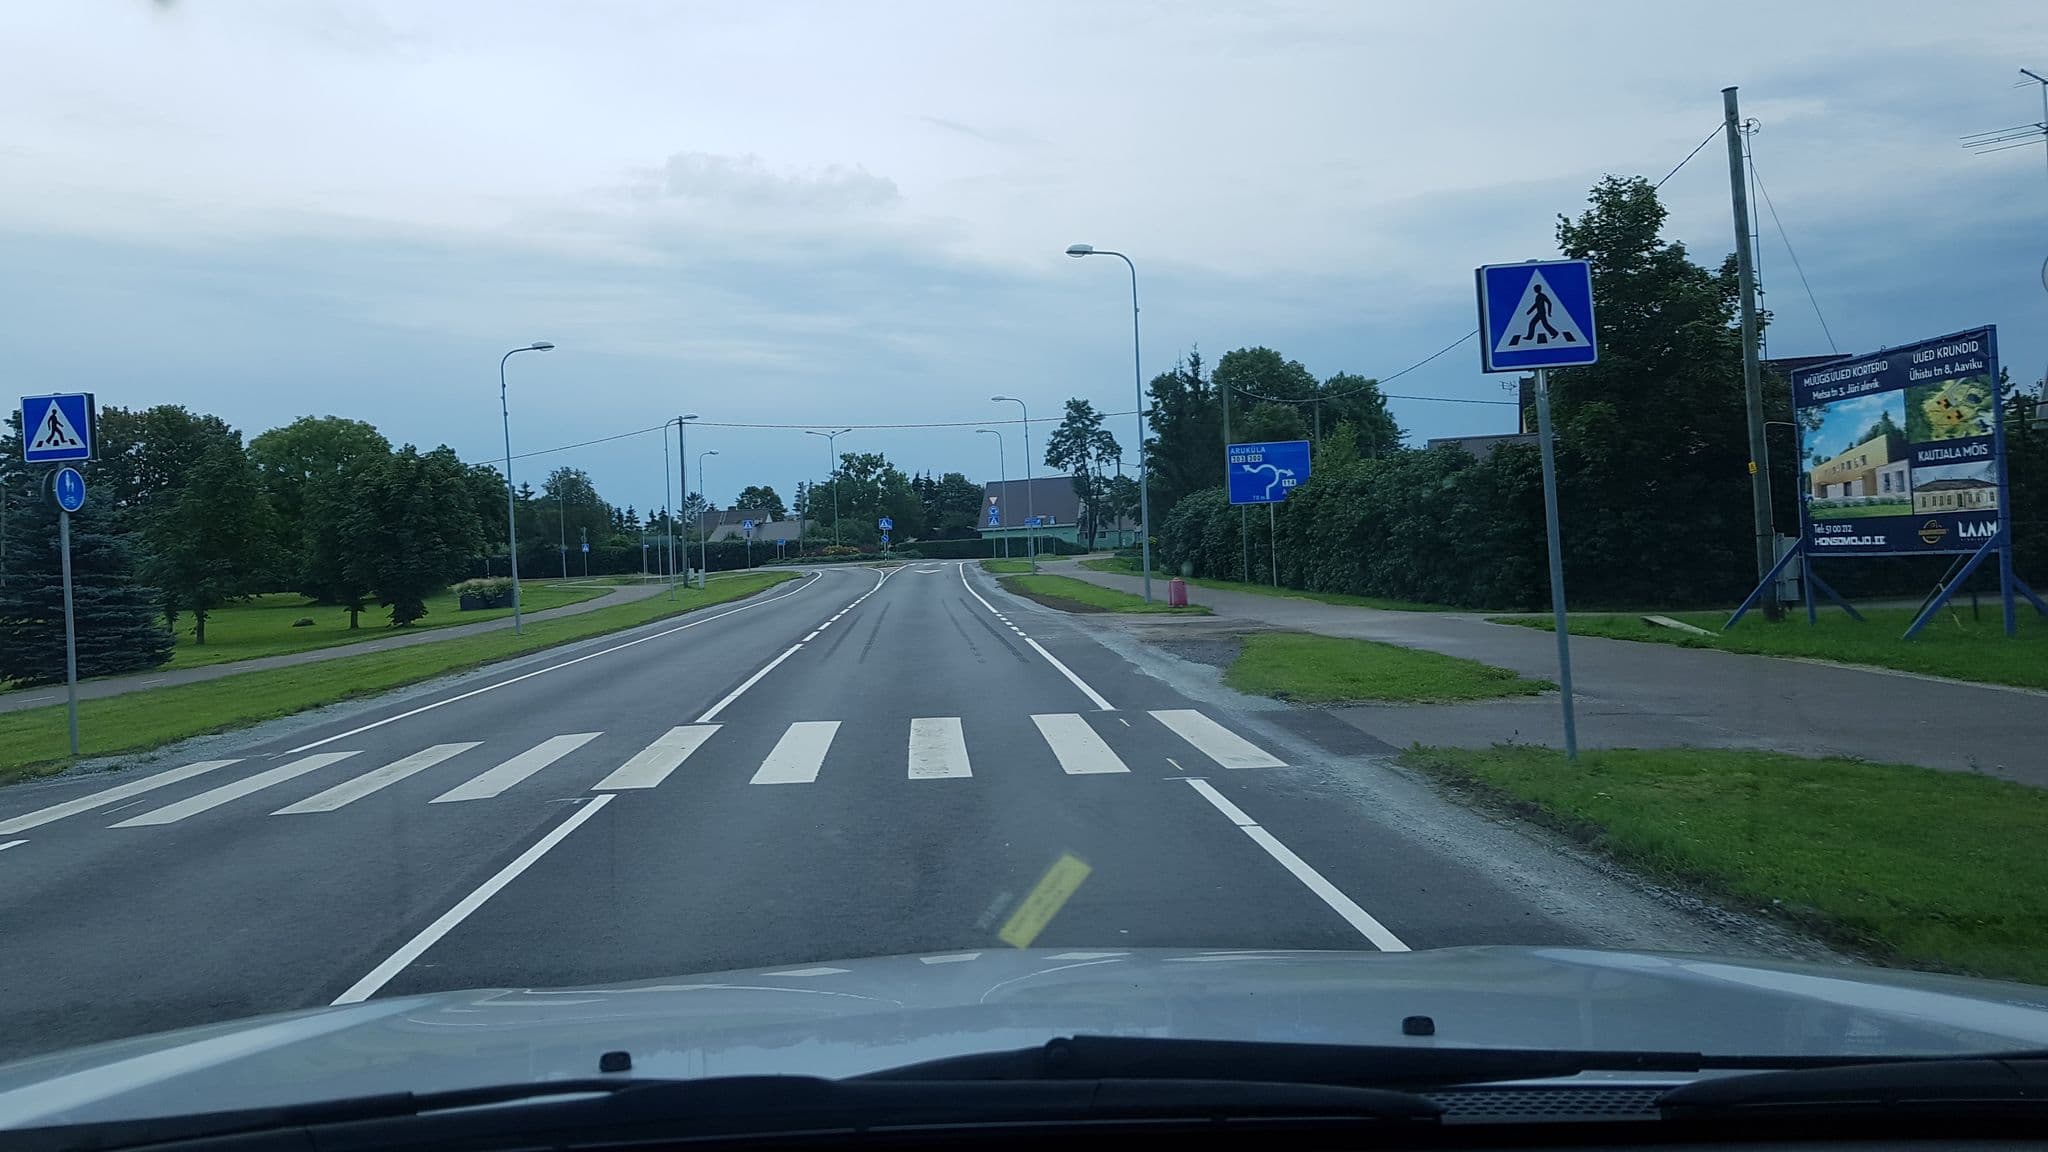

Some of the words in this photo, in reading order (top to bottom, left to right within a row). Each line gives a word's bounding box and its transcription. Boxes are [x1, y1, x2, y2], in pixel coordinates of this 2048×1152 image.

[1913, 349, 1935, 364] UUED
[1936, 340, 1979, 359] KRUNDID
[1831, 369, 1851, 381] UUED
[1852, 360, 1888, 377] KORTERID
[1909, 367, 1933, 381] Ühistu
[1933, 366, 1943, 377] tn
[1944, 364, 1953, 376] 8,
[1954, 358, 1983, 373] Aaviku
[1230, 446, 1266, 454] ARUKÜLA
[1918, 447, 1961, 462] KAUTJALA
[1962, 442, 1988, 457] MÕIS
[1958, 520, 1997, 537] LAAM
